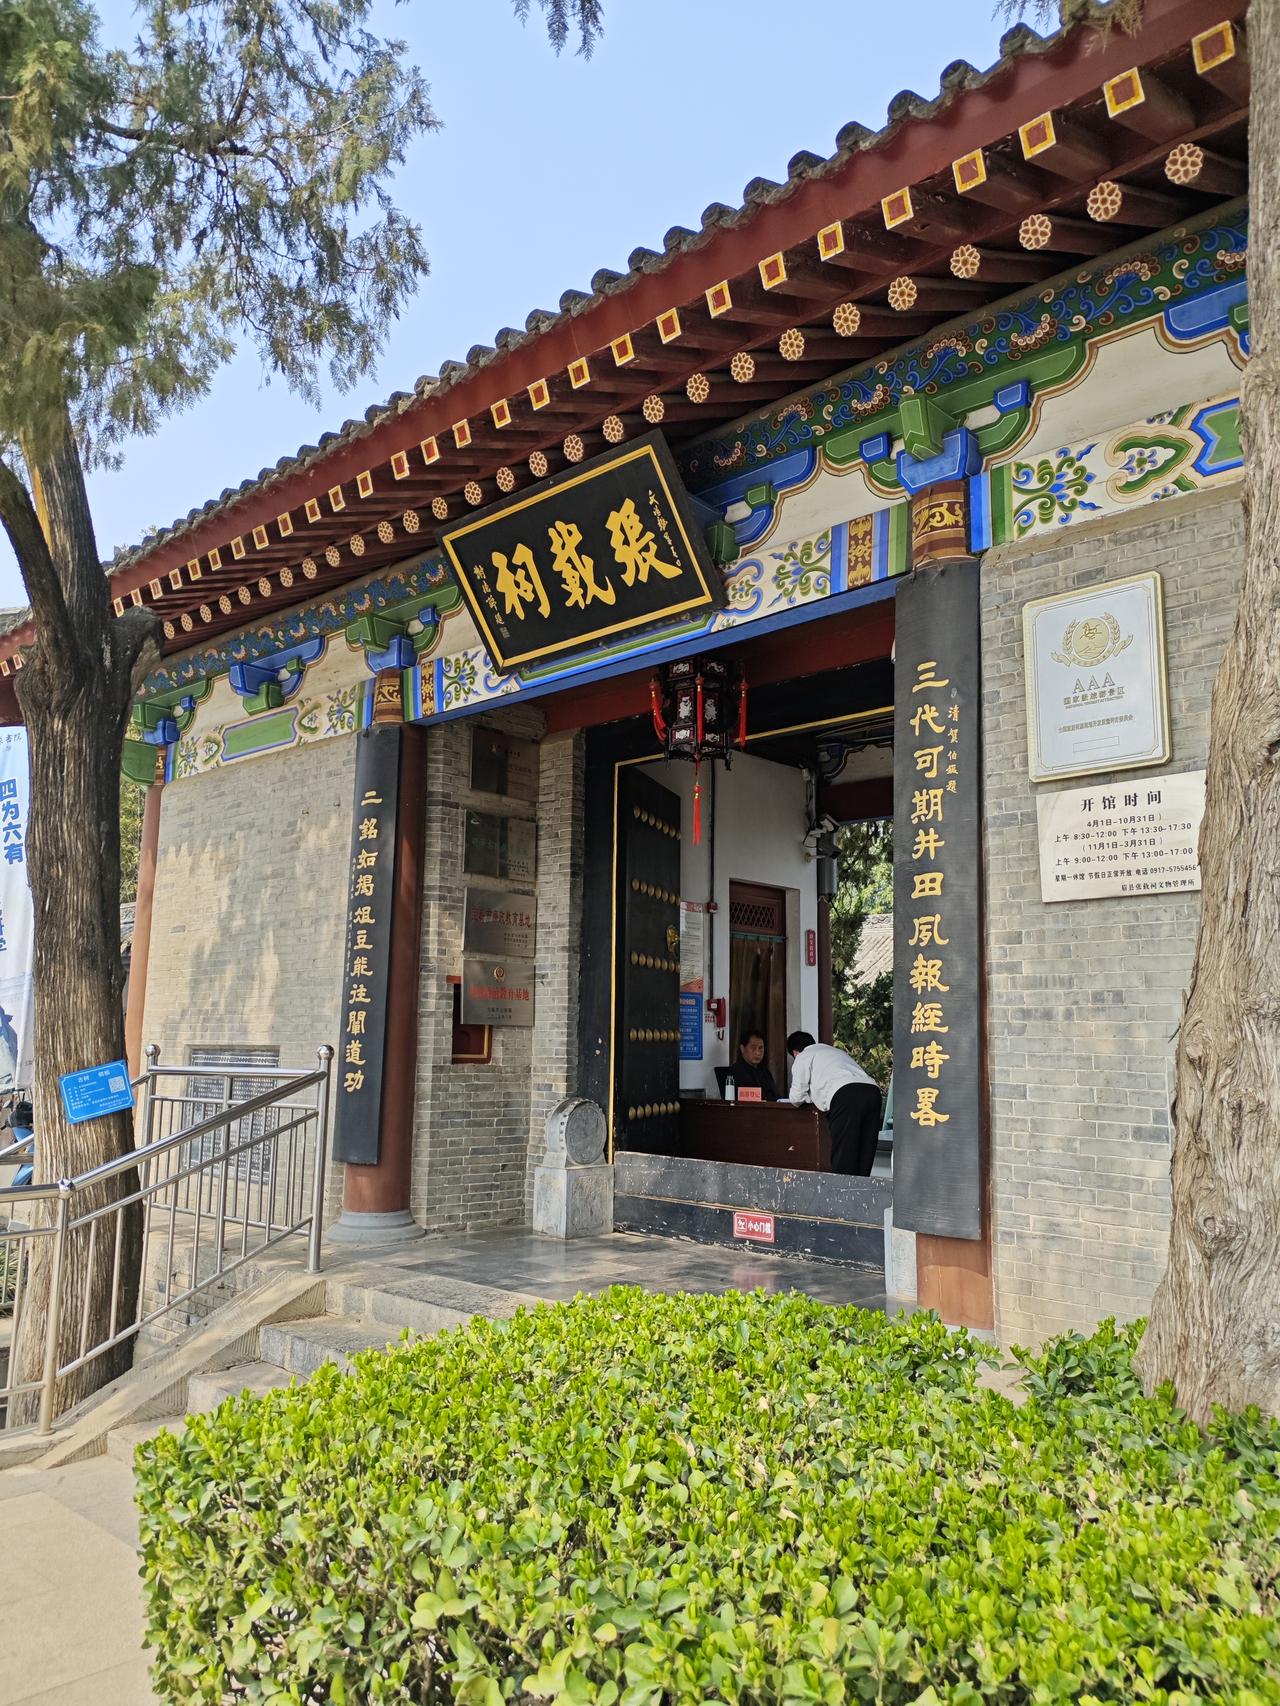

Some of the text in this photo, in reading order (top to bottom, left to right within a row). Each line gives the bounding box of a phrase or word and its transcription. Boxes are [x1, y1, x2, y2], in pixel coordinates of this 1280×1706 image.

[1073, 671, 1116, 695] AAA
[1081, 790, 1161, 812] 开馆时间
[0, 778, 24, 865] 四为六有
[1055, 823, 1192, 843] 上午 8:30-12:00 下午 13:30-17:30
[1055, 847, 1193, 866] 上午 9:00-12:00 下午 13:00-17:00
[1055, 873, 1085, 882] 星期一休馆
[1088, 869, 1132, 880] 节假日正常开放
[1135, 868, 1148, 876] 电话
